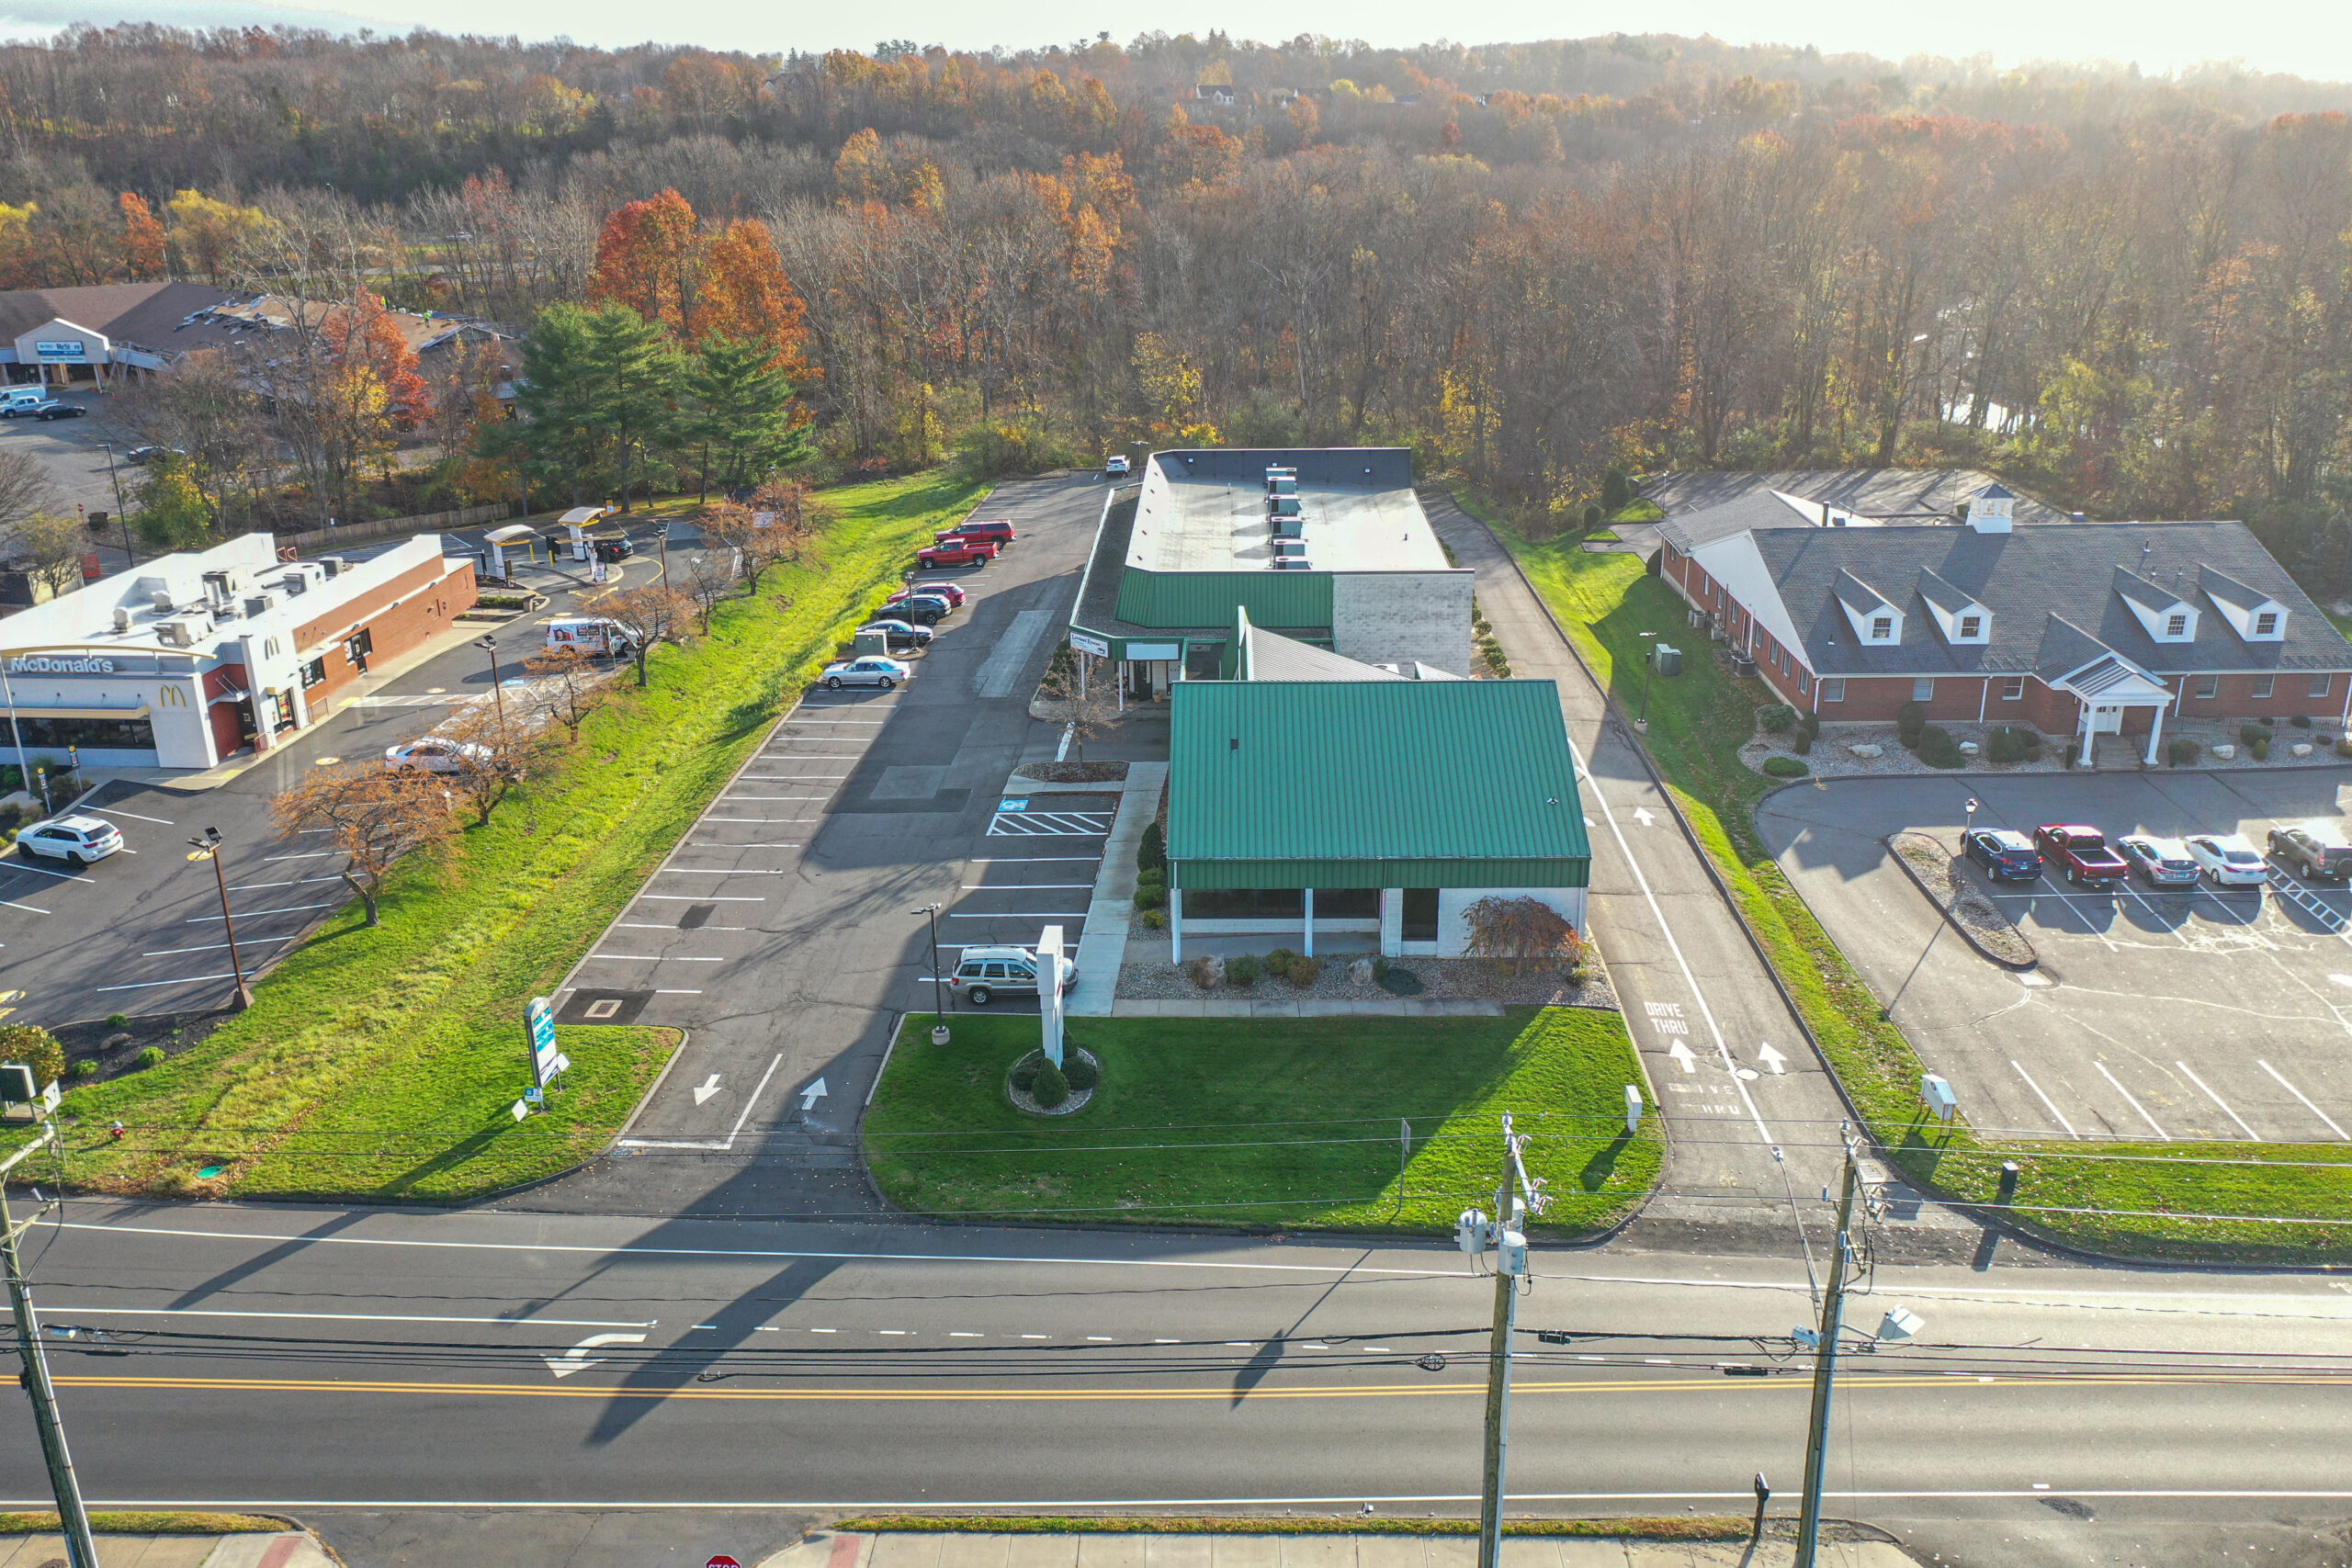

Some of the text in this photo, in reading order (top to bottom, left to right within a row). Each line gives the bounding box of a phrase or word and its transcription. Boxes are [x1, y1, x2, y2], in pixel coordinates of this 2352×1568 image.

[11, 657, 114, 673] McDonald's
[1644, 1001, 1684, 1018] DRIVE
[1650, 1018, 1689, 1034] THRU
